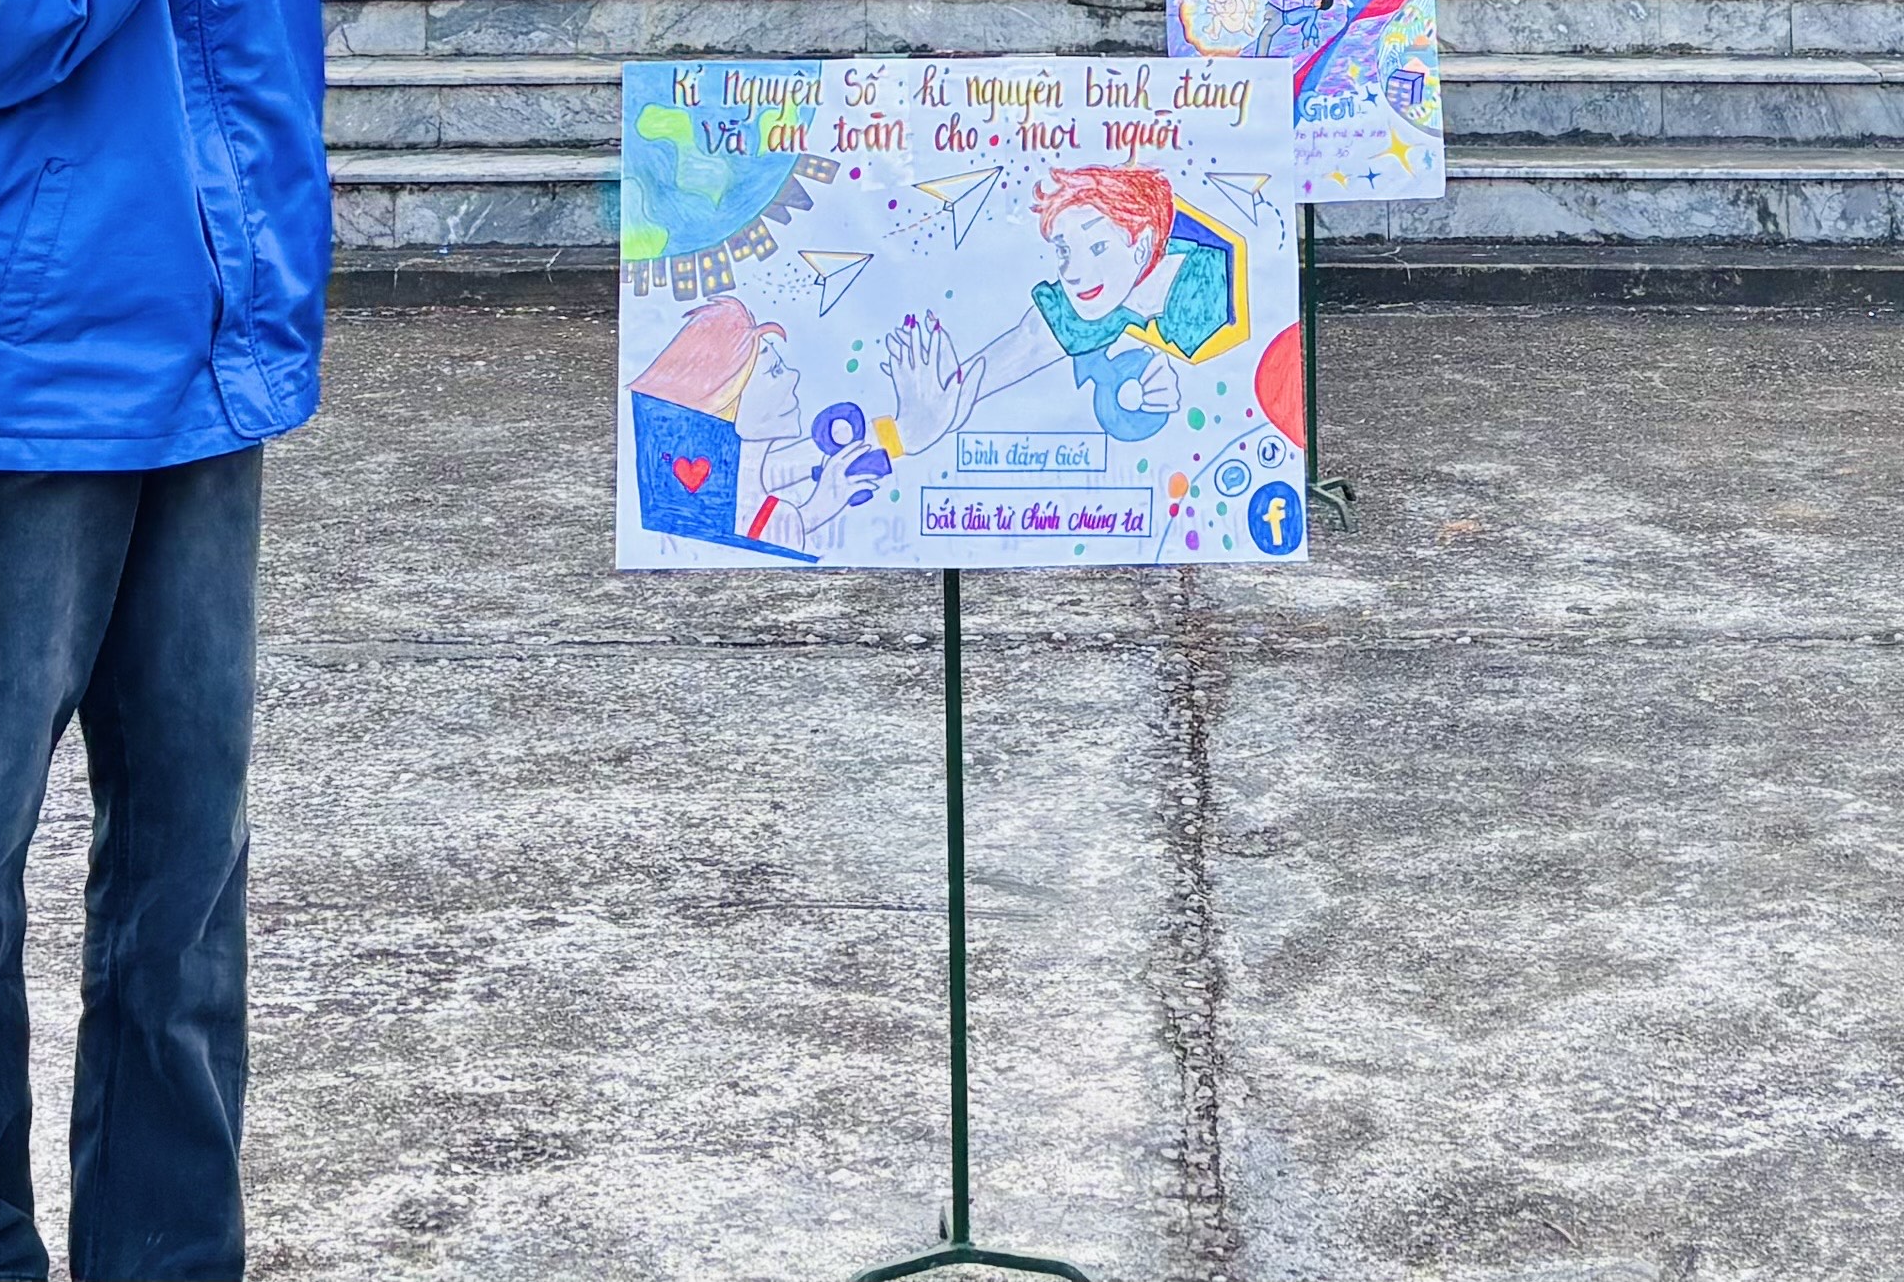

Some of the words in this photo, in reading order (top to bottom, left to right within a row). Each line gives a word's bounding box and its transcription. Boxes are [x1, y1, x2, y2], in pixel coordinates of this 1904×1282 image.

[966, 69, 1063, 123] nguyên
[1086, 64, 1152, 110] bình
[768, 124, 808, 152] an
[830, 112, 907, 153] toàn
[935, 112, 978, 152] cho
[1016, 118, 1081, 158] mọi
[1102, 109, 1182, 165] người
[962, 438, 999, 465] bình
[926, 498, 956, 529] bắt
[962, 502, 990, 530] đầu
[1121, 508, 1143, 532] ta
